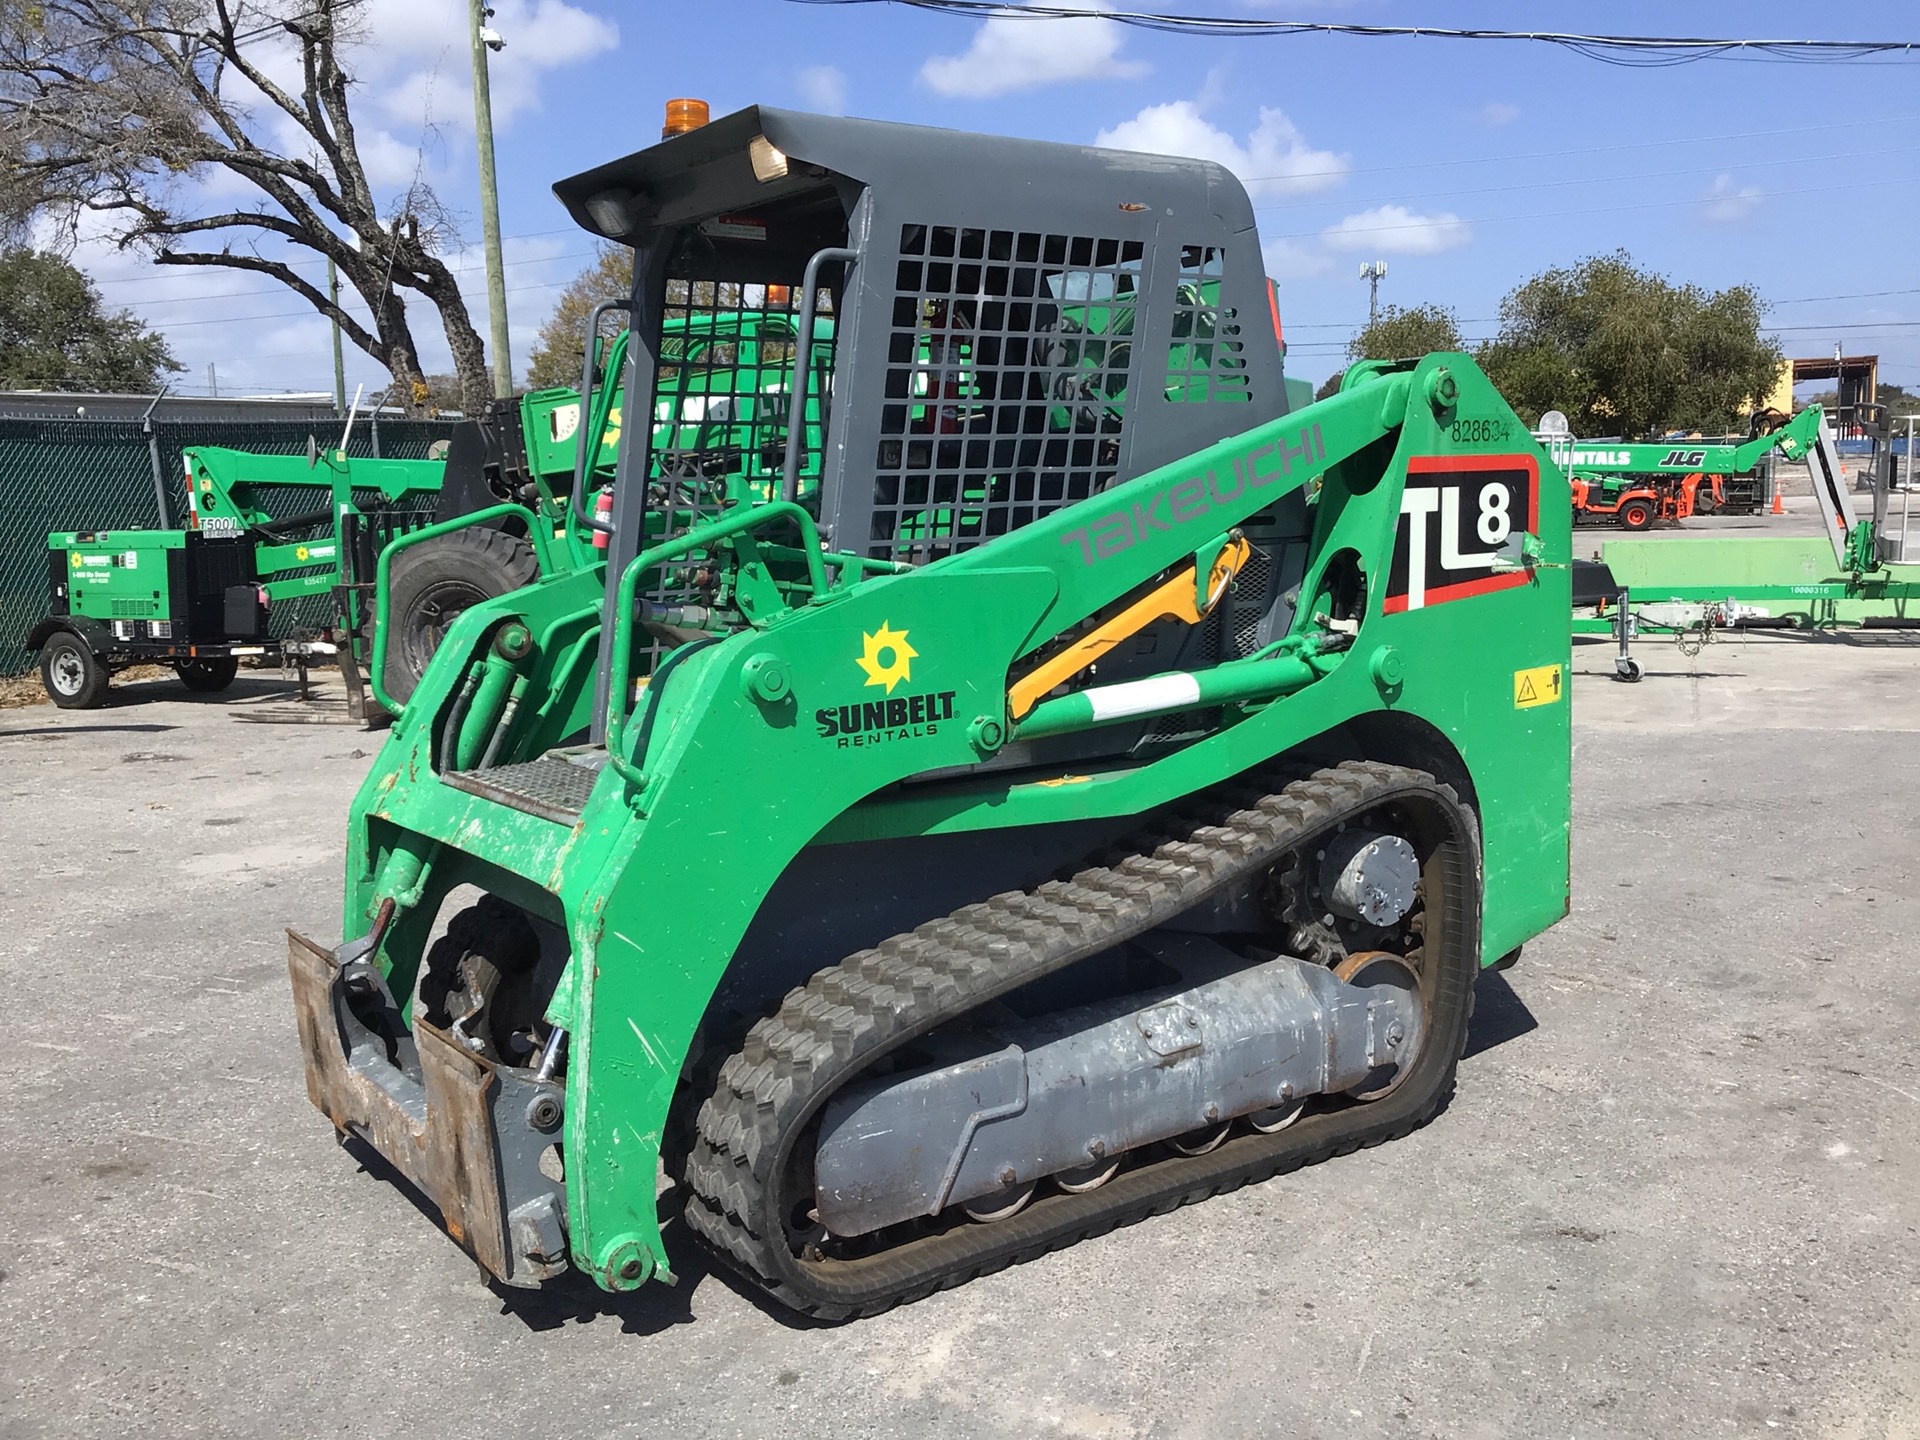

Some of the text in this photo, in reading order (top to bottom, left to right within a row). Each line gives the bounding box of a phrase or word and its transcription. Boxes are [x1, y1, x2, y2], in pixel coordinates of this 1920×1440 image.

[1452, 420, 1510, 442] 828634
[1658, 450, 1707, 467] JLG
[199, 518, 236, 530] T500J
[1399, 482, 1513, 611] TL8
[1790, 586, 1829, 594] 10000316
[816, 691, 956, 738] SUNBELT
[838, 724, 937, 749] RENTALS
